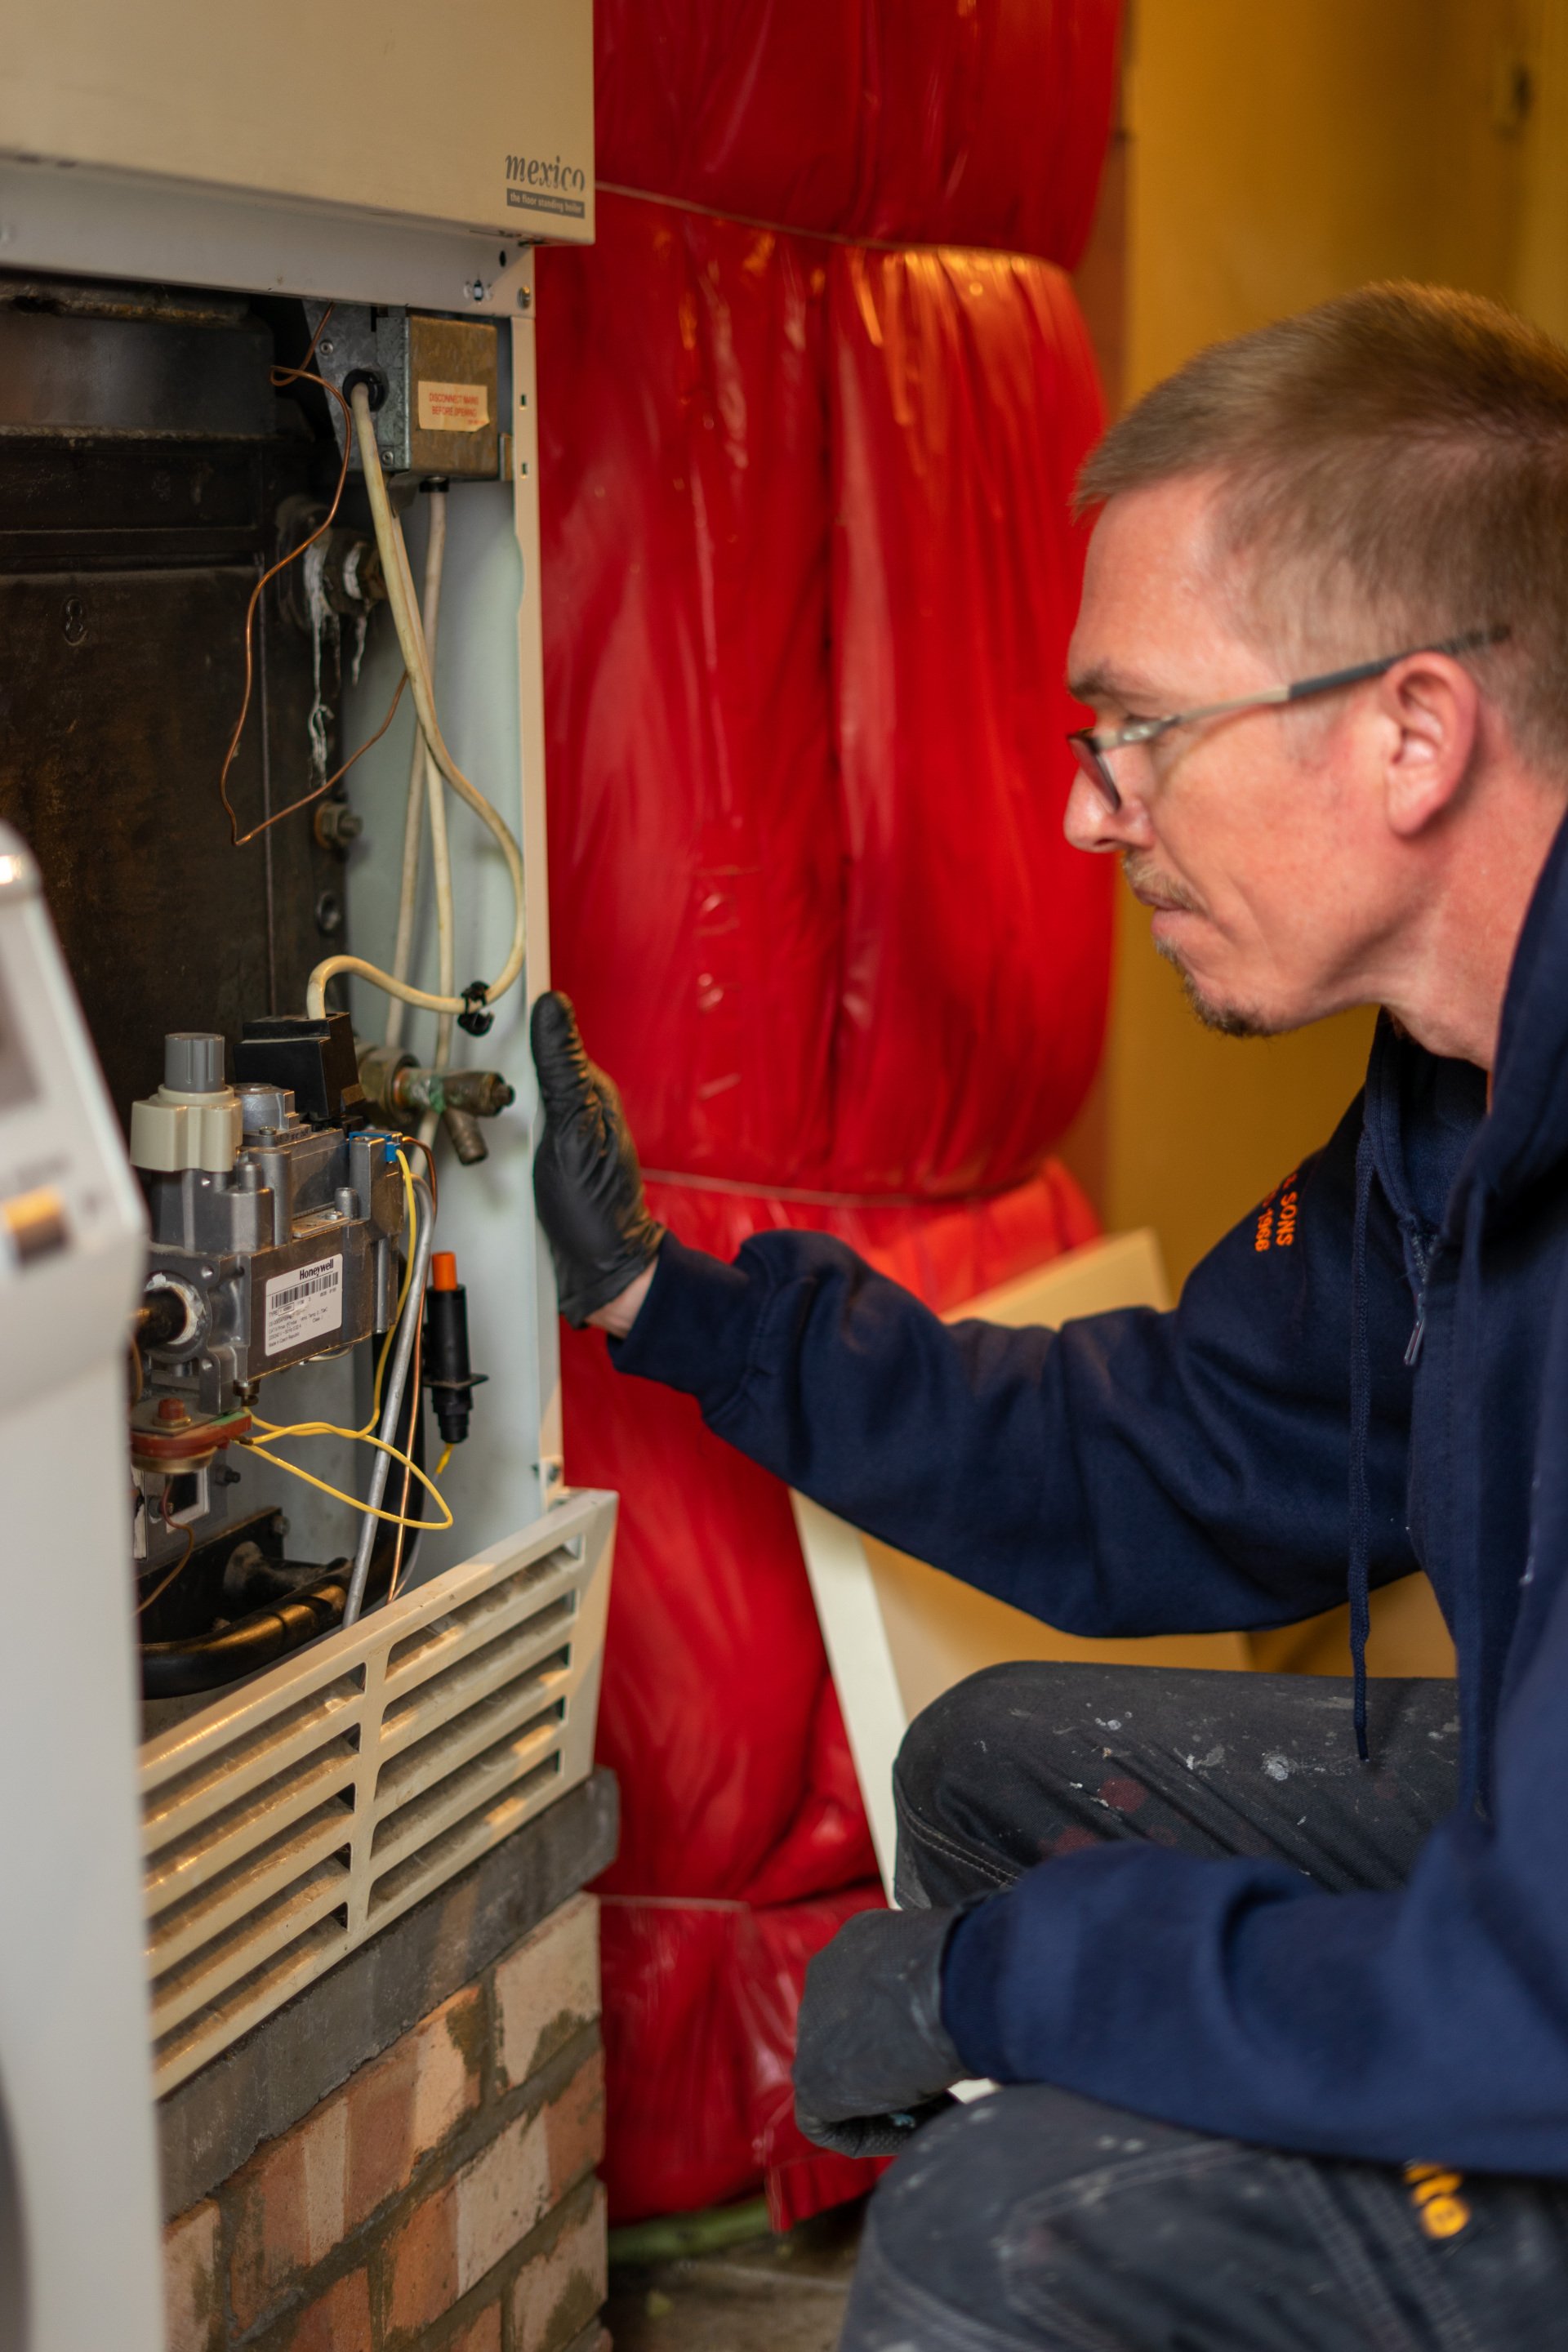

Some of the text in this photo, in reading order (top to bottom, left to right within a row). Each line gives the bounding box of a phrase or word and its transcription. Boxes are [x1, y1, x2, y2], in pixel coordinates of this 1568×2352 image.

[505, 154, 586, 192] mexico
[510, 192, 521, 203] the
[523, 194, 537, 205] floor
[538, 198, 564, 213] standing
[431, 405, 453, 416] BEFORE
[1276, 1192, 1298, 1246] SONS
[300, 1258, 334, 1281] Honeywell
